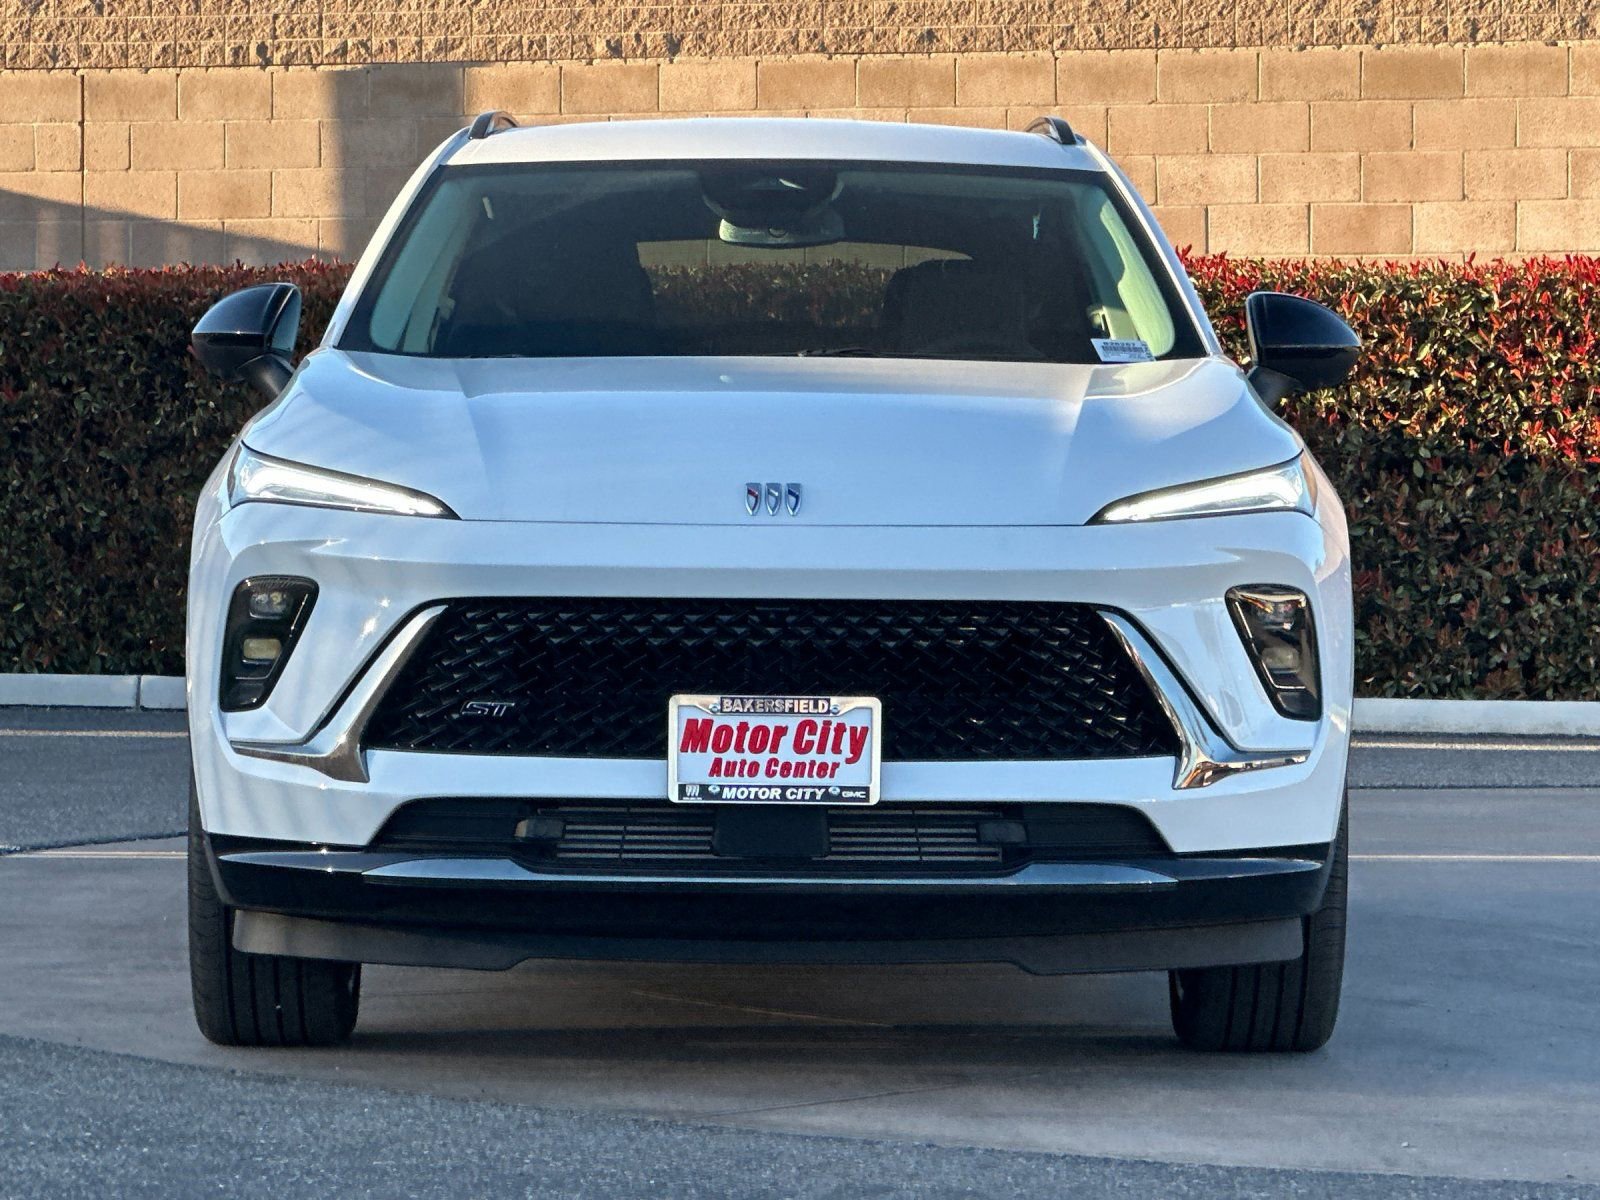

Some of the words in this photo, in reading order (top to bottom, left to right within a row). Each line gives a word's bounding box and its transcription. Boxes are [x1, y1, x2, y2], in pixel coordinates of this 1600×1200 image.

[721, 698, 829, 714] BAKERSFIELD
[680, 718, 789, 755] Motor
[792, 719, 870, 764] City
[708, 757, 760, 778] Auto
[764, 757, 840, 779] Center
[721, 787, 782, 800] MOTOR
[785, 788, 826, 801] CITY
